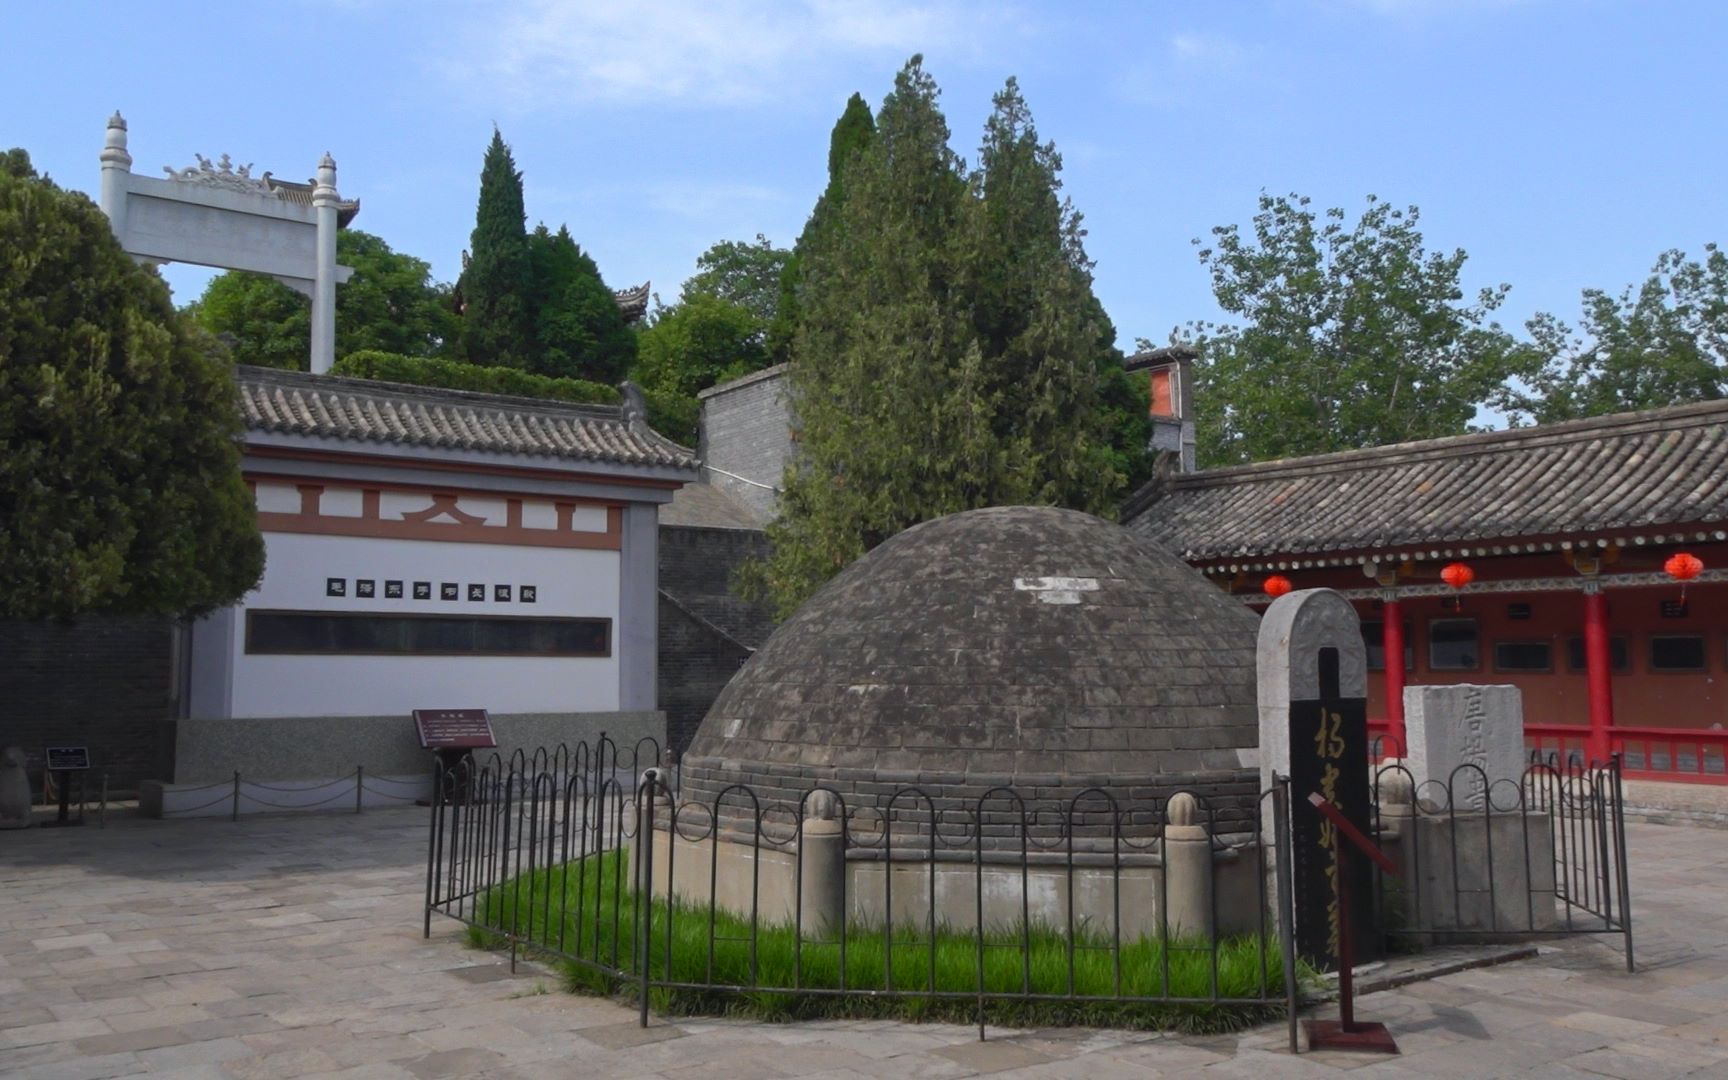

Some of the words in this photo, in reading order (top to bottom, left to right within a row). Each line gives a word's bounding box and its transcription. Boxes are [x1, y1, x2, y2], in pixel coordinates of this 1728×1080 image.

[328, 580, 536, 601] 毛泽东手书长恨歌
